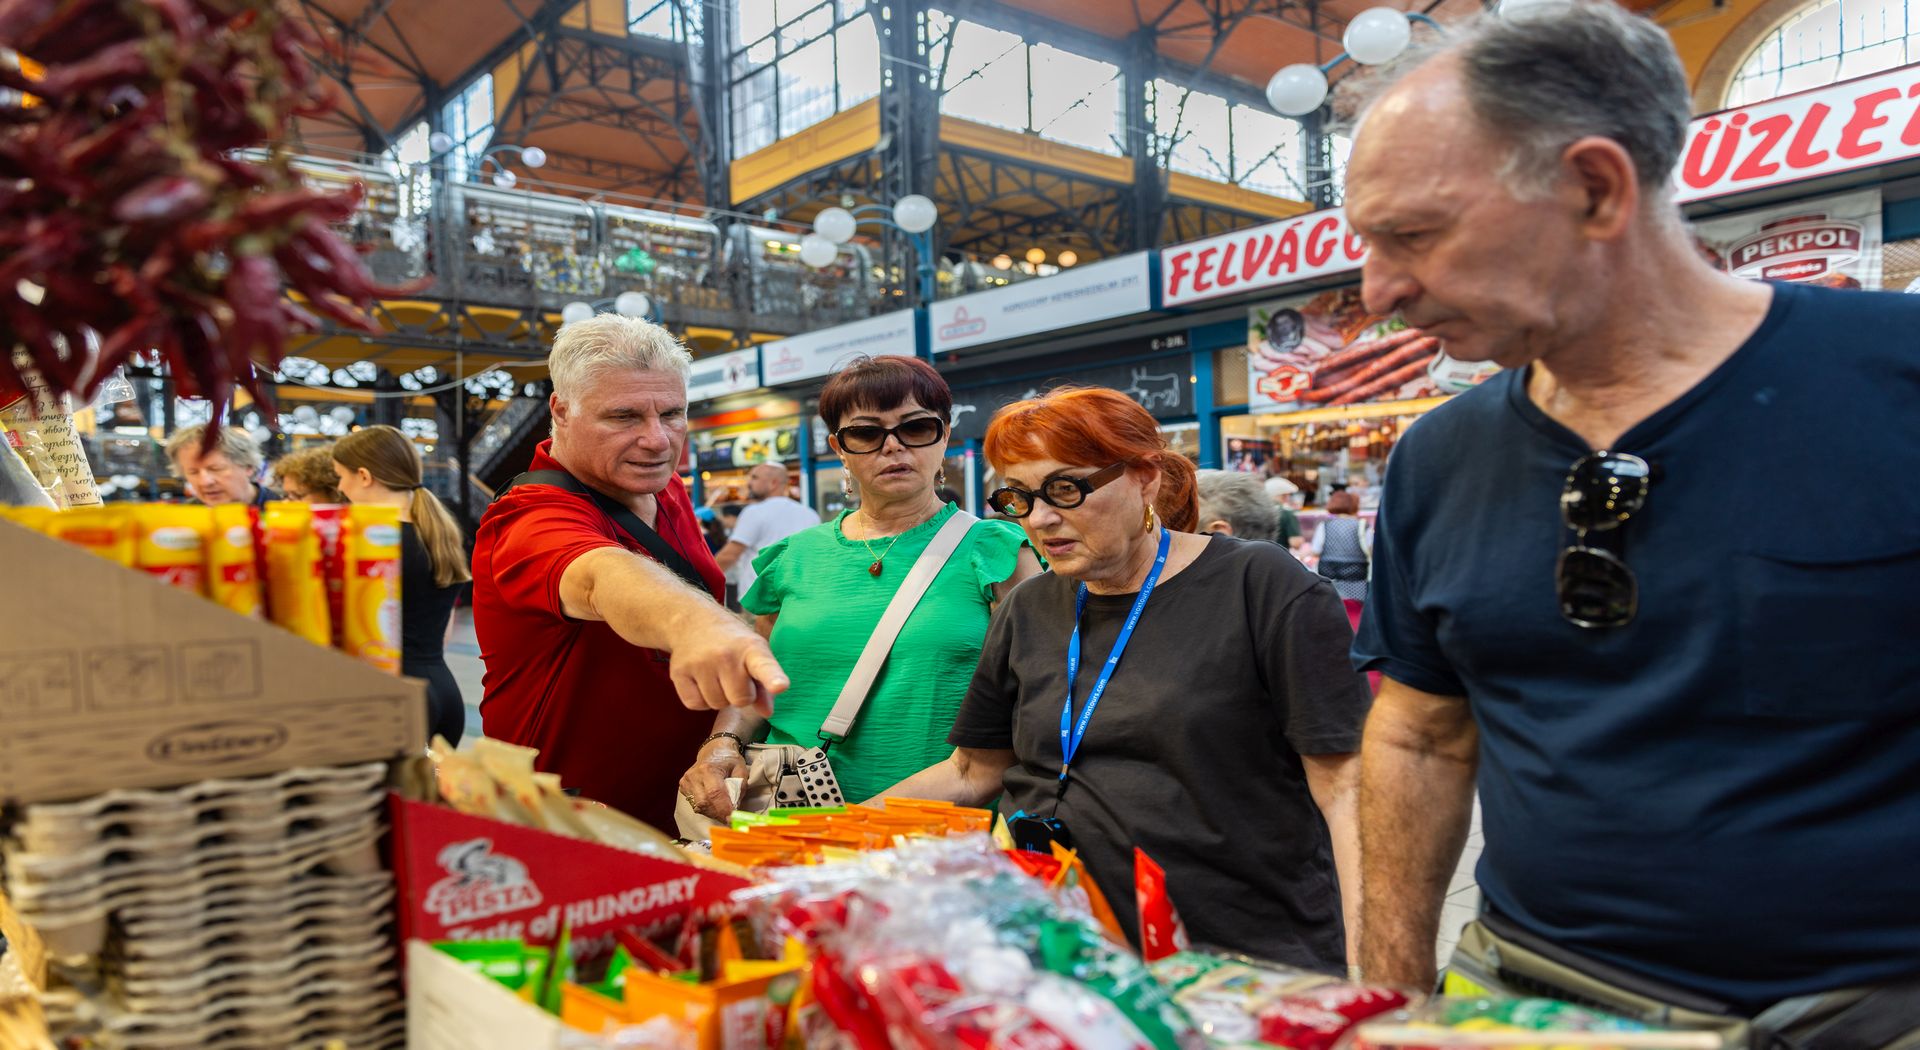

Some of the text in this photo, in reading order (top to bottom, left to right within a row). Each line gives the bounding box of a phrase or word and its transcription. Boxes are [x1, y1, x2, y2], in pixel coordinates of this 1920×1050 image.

[1742, 229, 1852, 263] PEKPOL
[1127, 576, 1155, 630] www.voxtours.com
[1077, 678, 1107, 736] www.voxtours.com
[529, 904, 561, 941] of
[564, 874, 700, 930] HUNGARY
